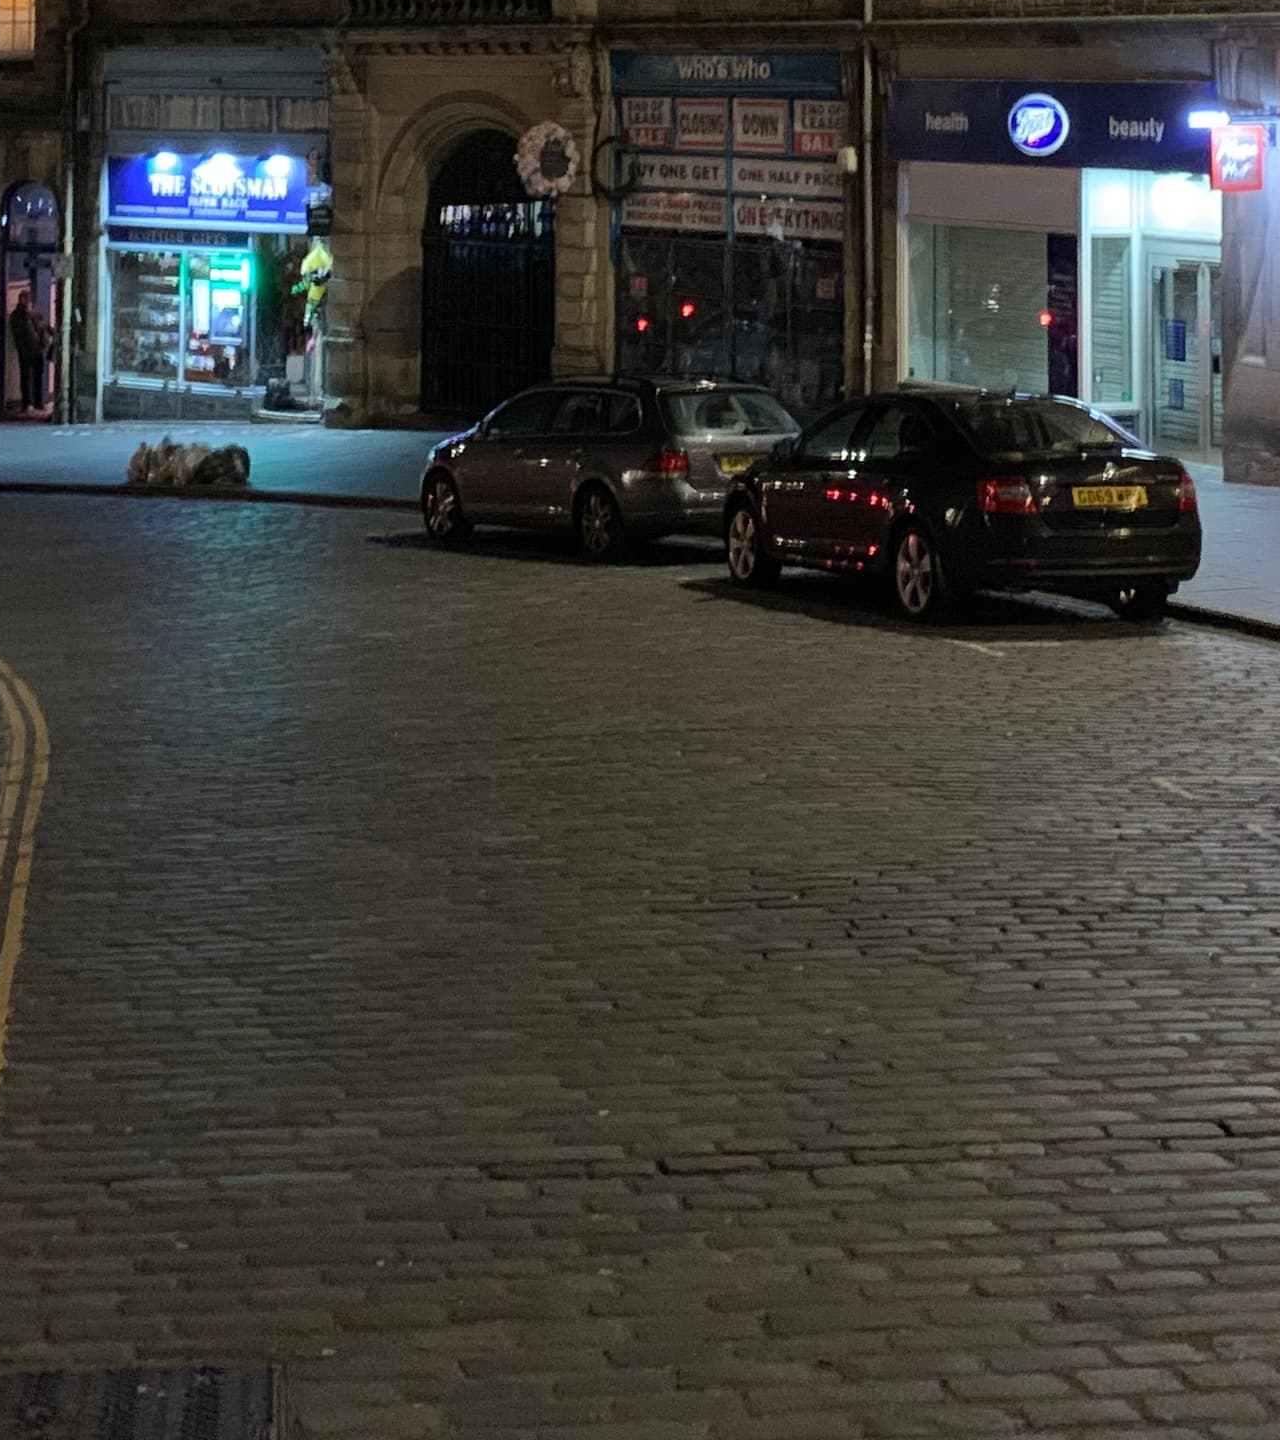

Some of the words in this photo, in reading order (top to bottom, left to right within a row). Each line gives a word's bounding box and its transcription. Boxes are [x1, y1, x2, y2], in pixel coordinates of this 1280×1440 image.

[679, 55, 728, 79] who's
[734, 58, 771, 79] who
[679, 112, 724, 135] CLOSING
[742, 113, 778, 137] DOWN
[925, 111, 969, 132] health
[1109, 116, 1165, 143] beauty
[660, 164, 687, 179] ONE
[691, 165, 719, 180] GET
[738, 167, 764, 182] ONE
[769, 169, 800, 184] HALF
[805, 172, 843, 186] PRICE
[148, 174, 186, 197] THE
[190, 176, 288, 200] SCOTSMAN
